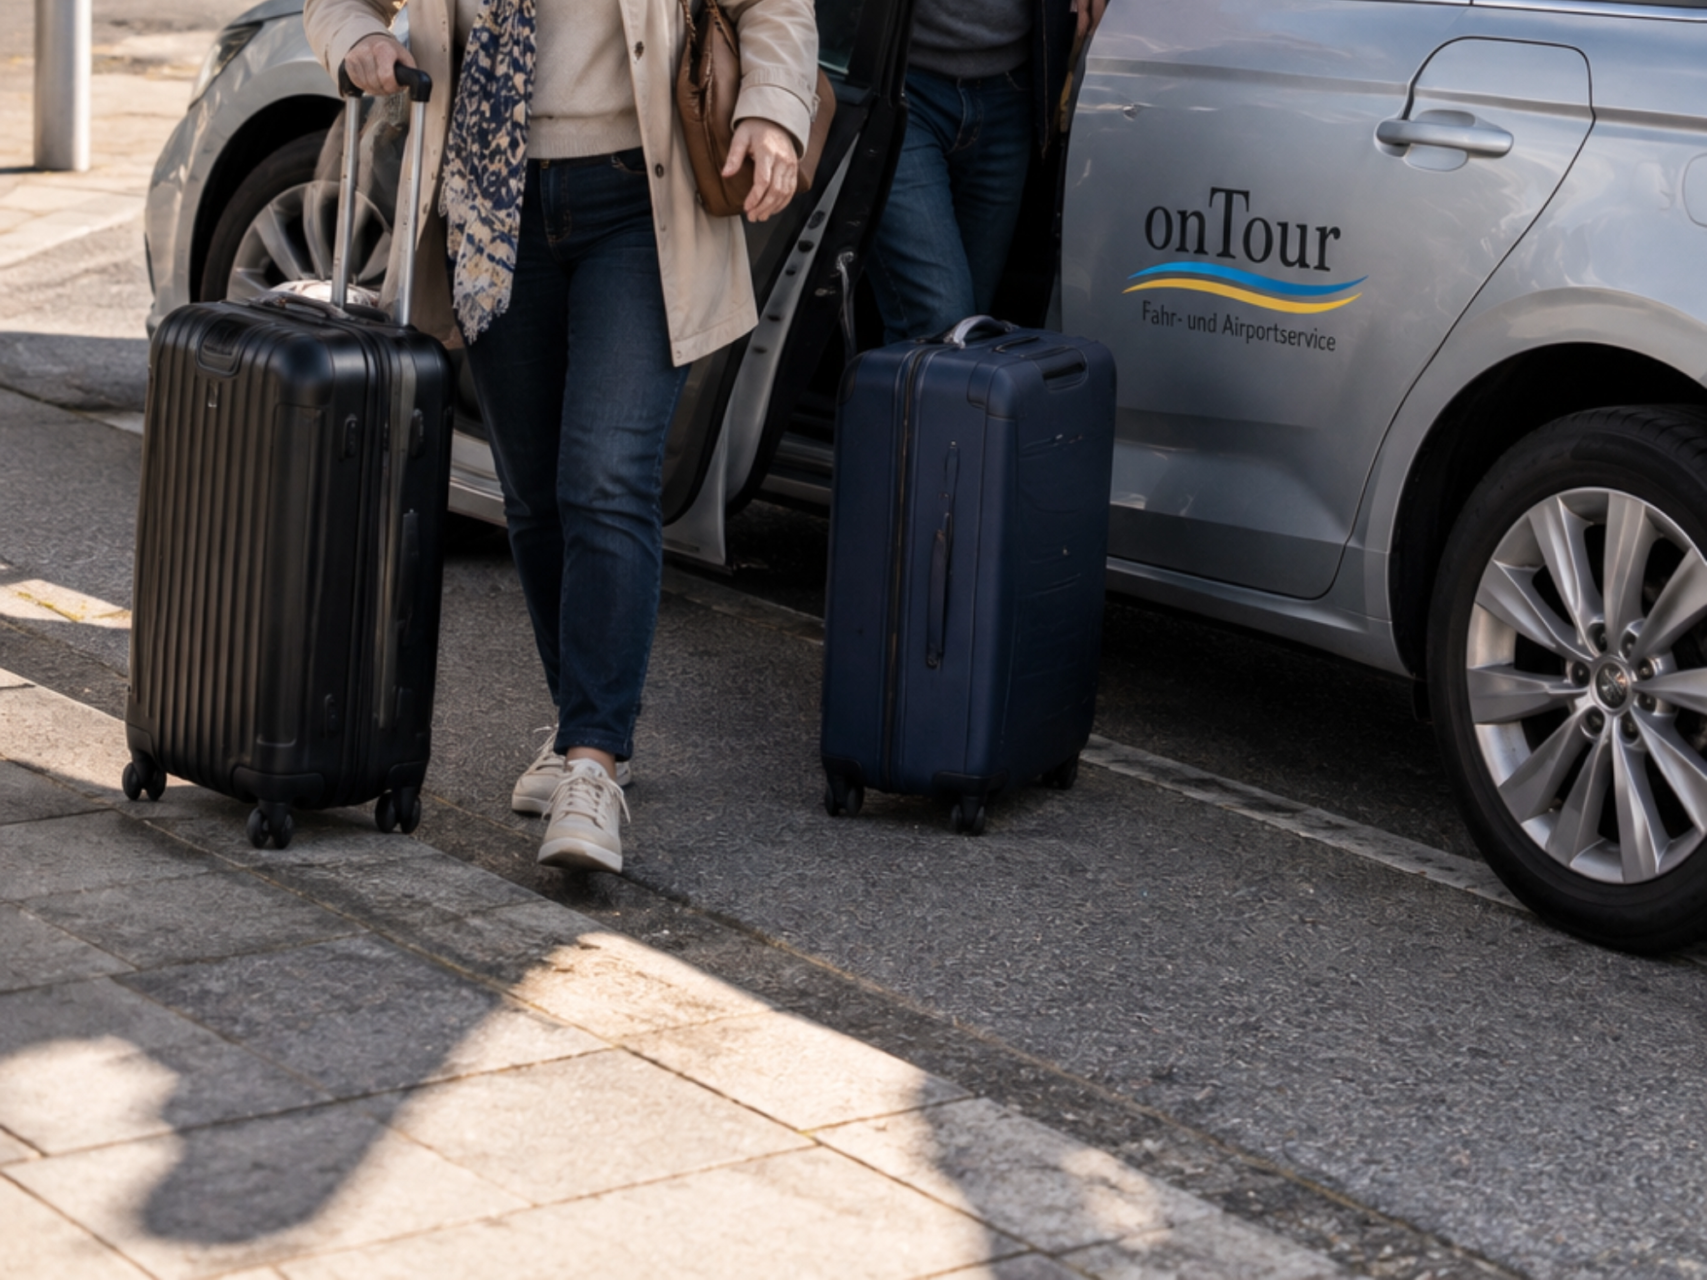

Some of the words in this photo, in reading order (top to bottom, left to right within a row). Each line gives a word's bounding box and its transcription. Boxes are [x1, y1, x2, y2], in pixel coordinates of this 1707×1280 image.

[1144, 186, 1341, 271] onTour
[1142, 300, 1182, 327] Fahr-
[1188, 312, 1217, 334] und
[1222, 314, 1336, 351] Airportservice
